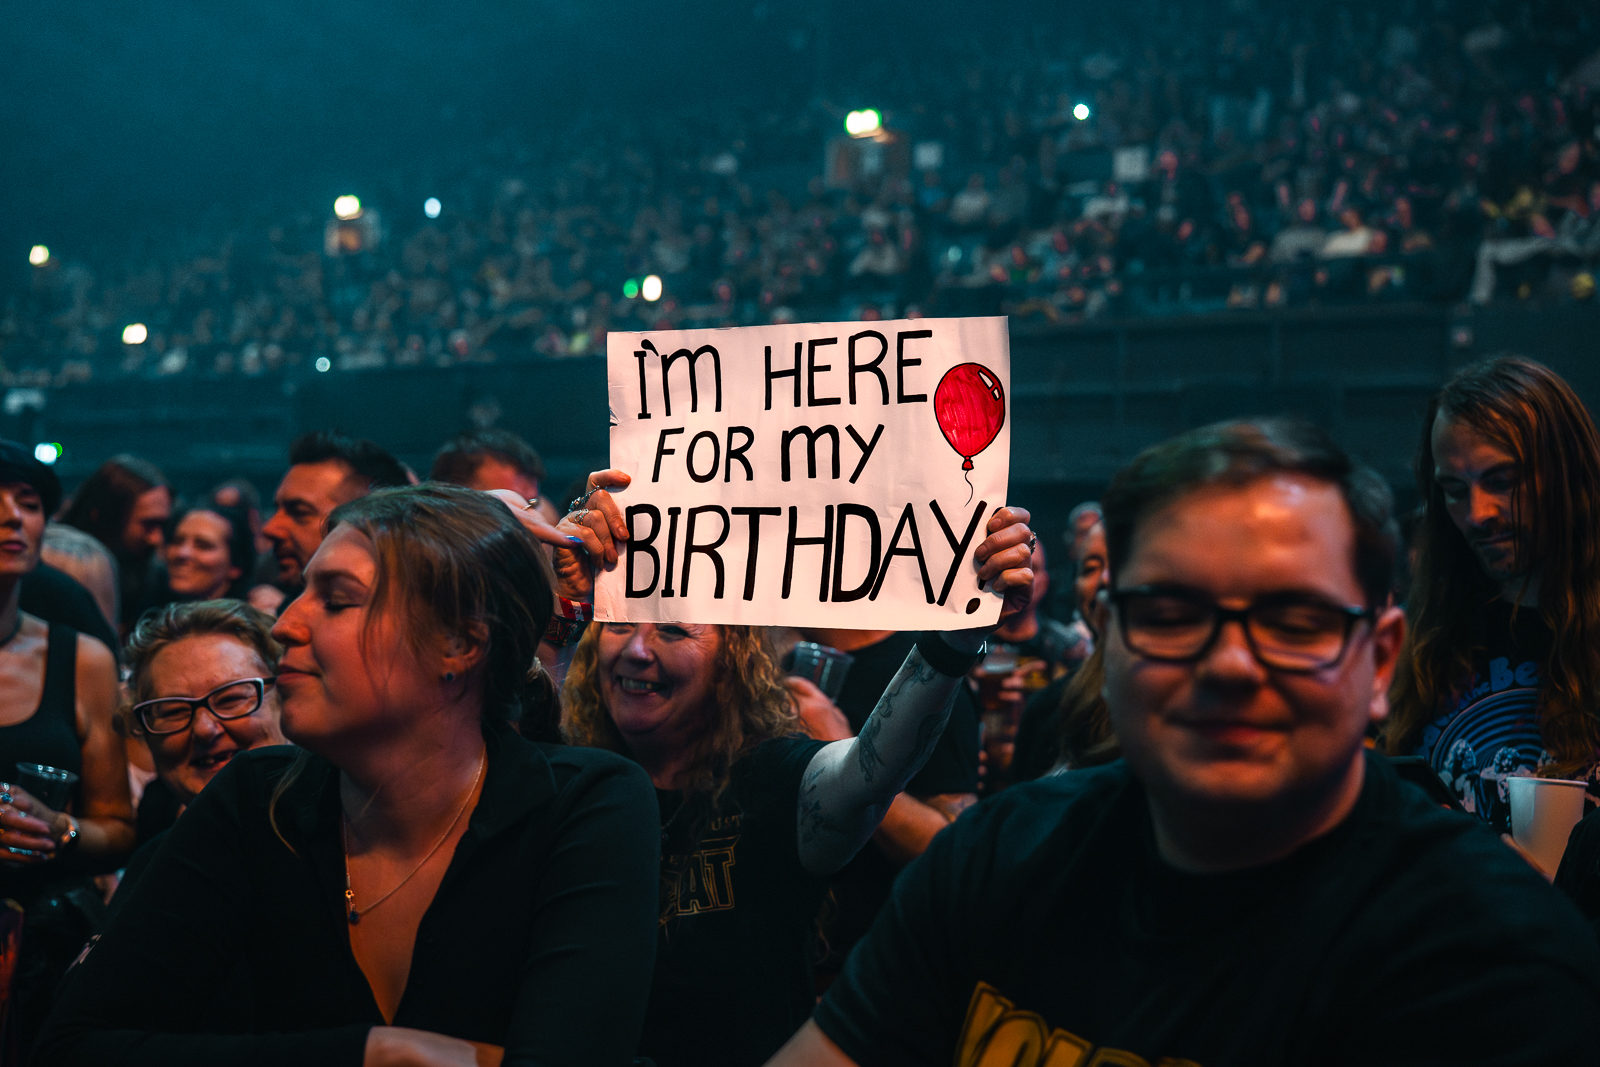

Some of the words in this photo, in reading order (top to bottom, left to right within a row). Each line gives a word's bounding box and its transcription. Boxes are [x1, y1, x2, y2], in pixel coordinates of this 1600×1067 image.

[765, 330, 932, 410] HERE
[652, 426, 754, 483] FOR
[624, 500, 986, 614] BIRTHDAY
[1489, 656, 1540, 692] Be
